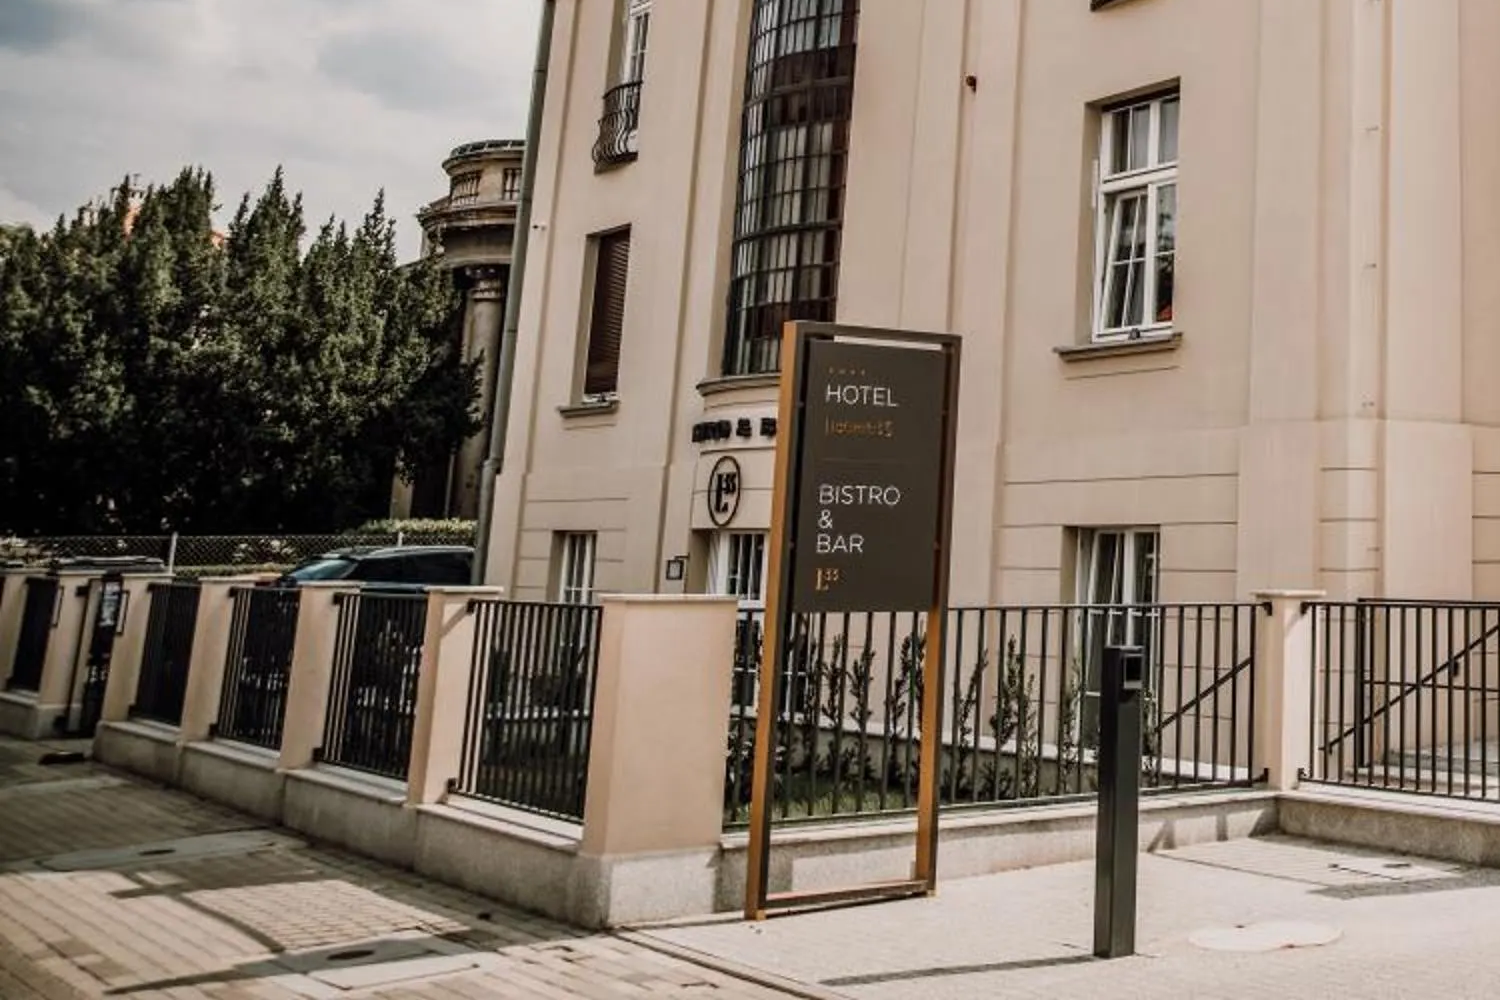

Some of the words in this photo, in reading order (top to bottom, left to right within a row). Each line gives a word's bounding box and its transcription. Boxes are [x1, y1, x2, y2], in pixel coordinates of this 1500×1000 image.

[825, 384, 899, 407] HOTEL
[818, 485, 901, 506] BISTRO
[818, 509, 833, 529] &
[816, 533, 864, 553] BAR
